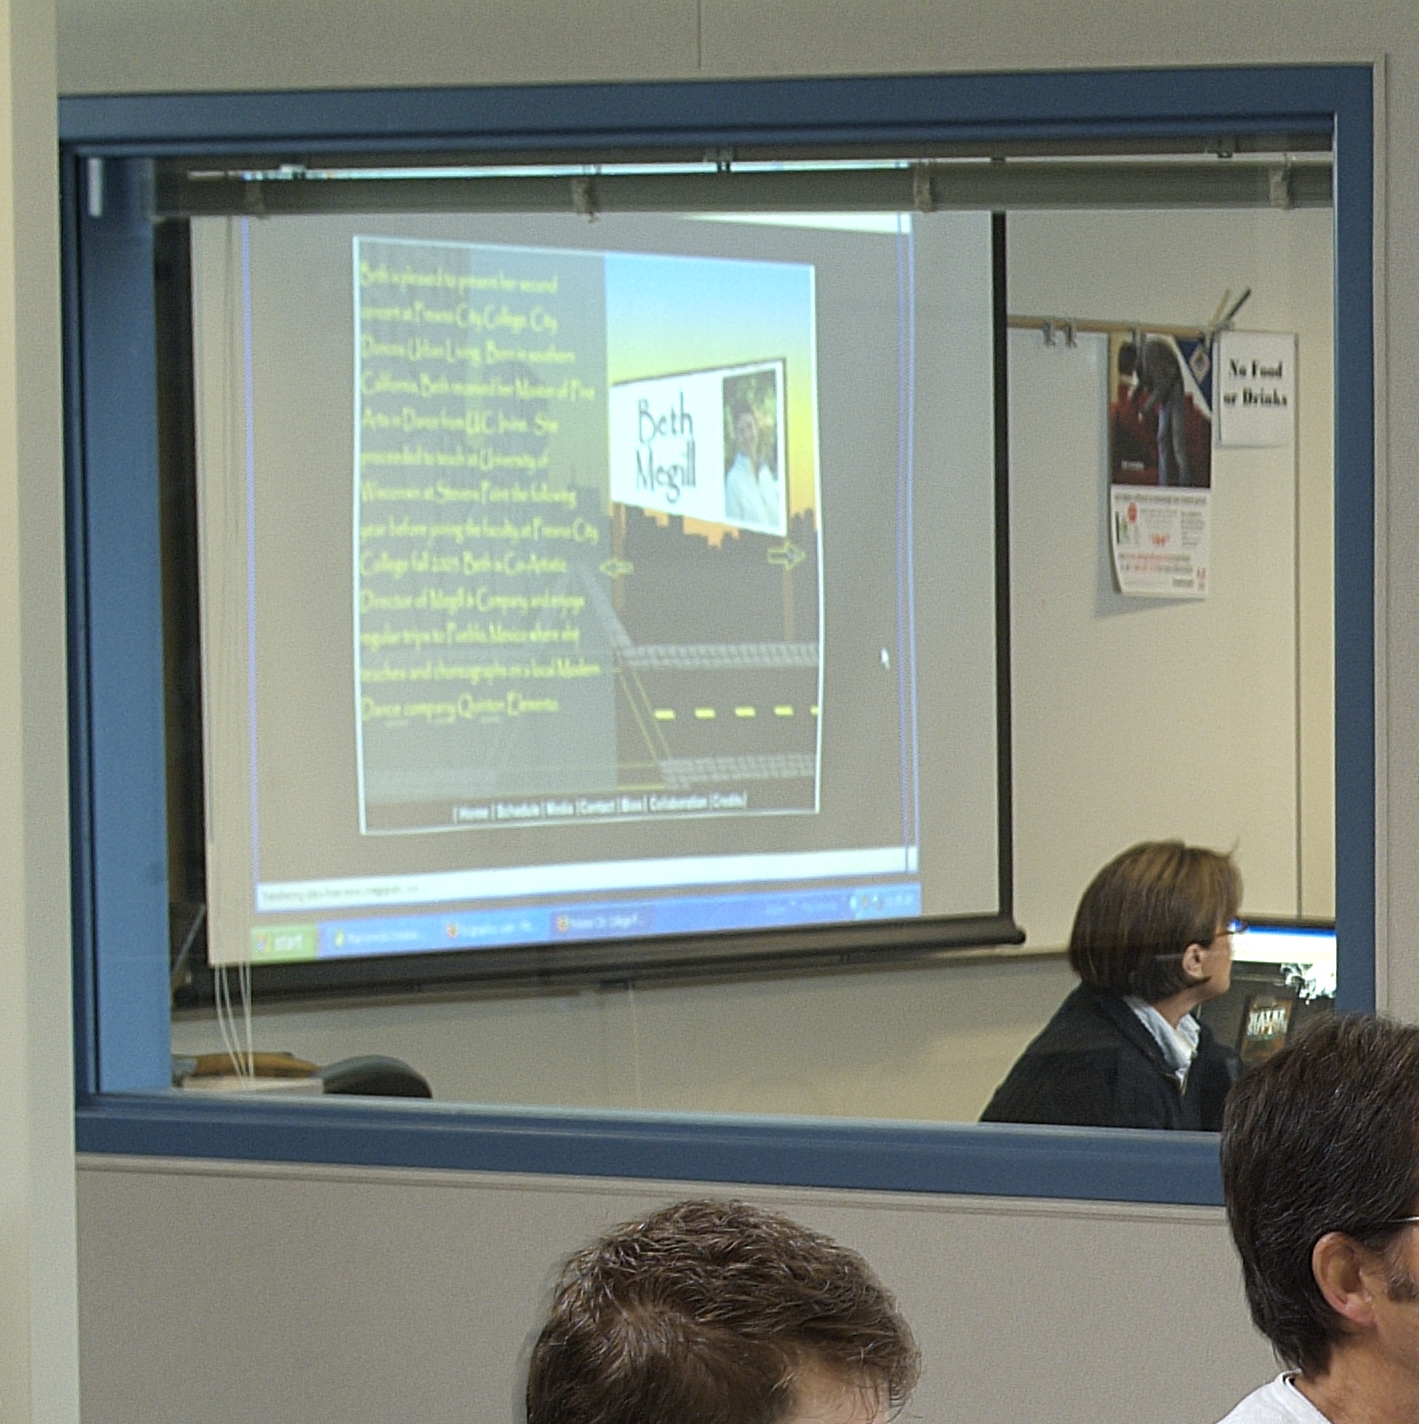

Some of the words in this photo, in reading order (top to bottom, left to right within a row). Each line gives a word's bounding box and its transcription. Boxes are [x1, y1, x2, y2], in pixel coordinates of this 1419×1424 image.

[1229, 359, 1247, 378] No
[1252, 360, 1283, 379] Food
[1224, 392, 1238, 405] or
[1242, 387, 1288, 407] Drinks
[638, 390, 694, 443] Beth
[636, 439, 696, 504] Megill
